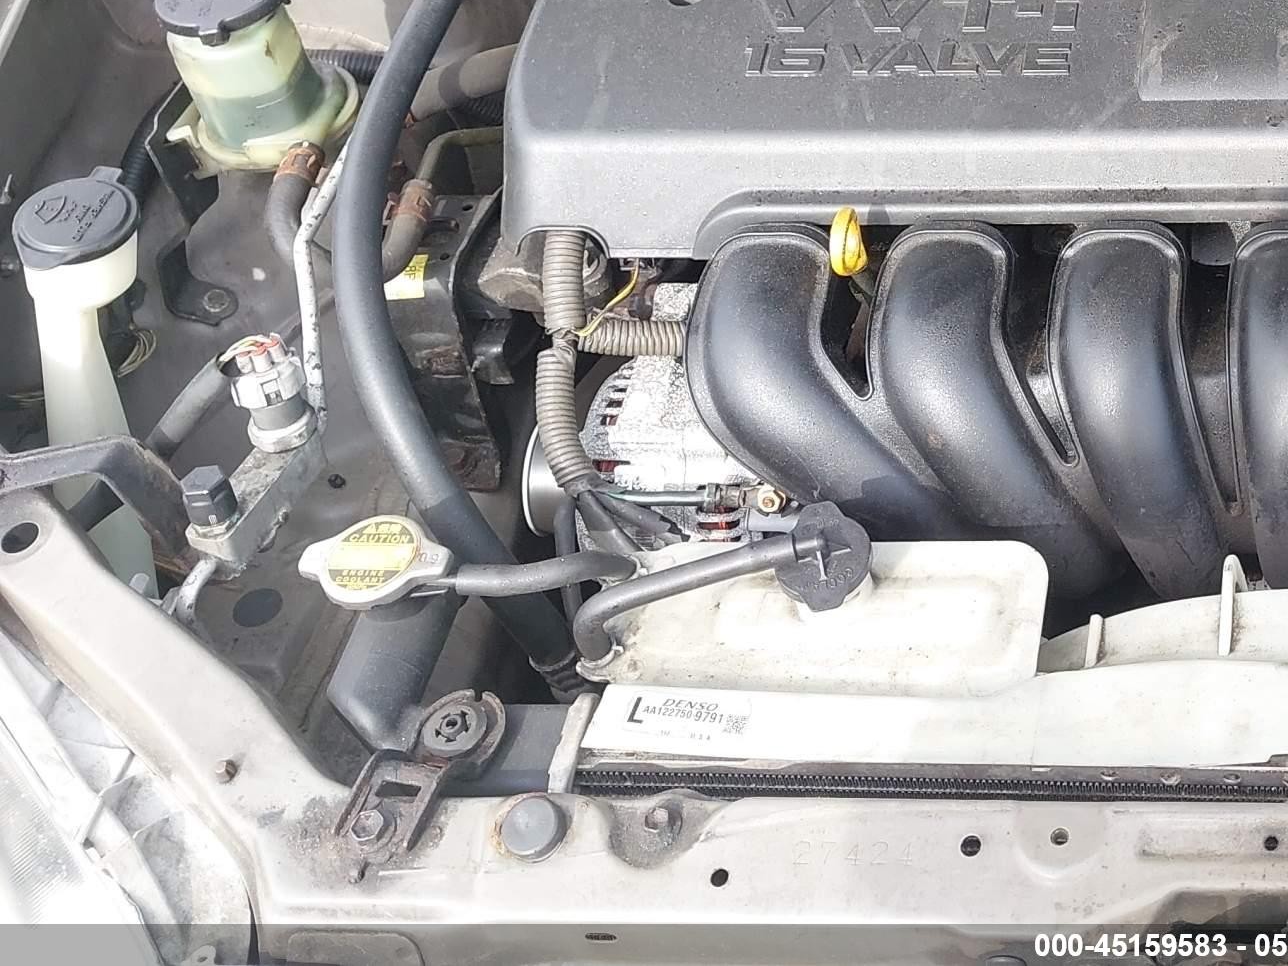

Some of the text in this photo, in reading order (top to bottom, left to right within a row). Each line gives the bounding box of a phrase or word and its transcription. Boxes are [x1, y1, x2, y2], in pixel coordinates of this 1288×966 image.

[745, 42, 1072, 77] 16 VALVE
[350, 534, 410, 543] CAUTION
[342, 569, 385, 577] ENGINE
[627, 696, 644, 724] L
[662, 698, 719, 712] DENSO
